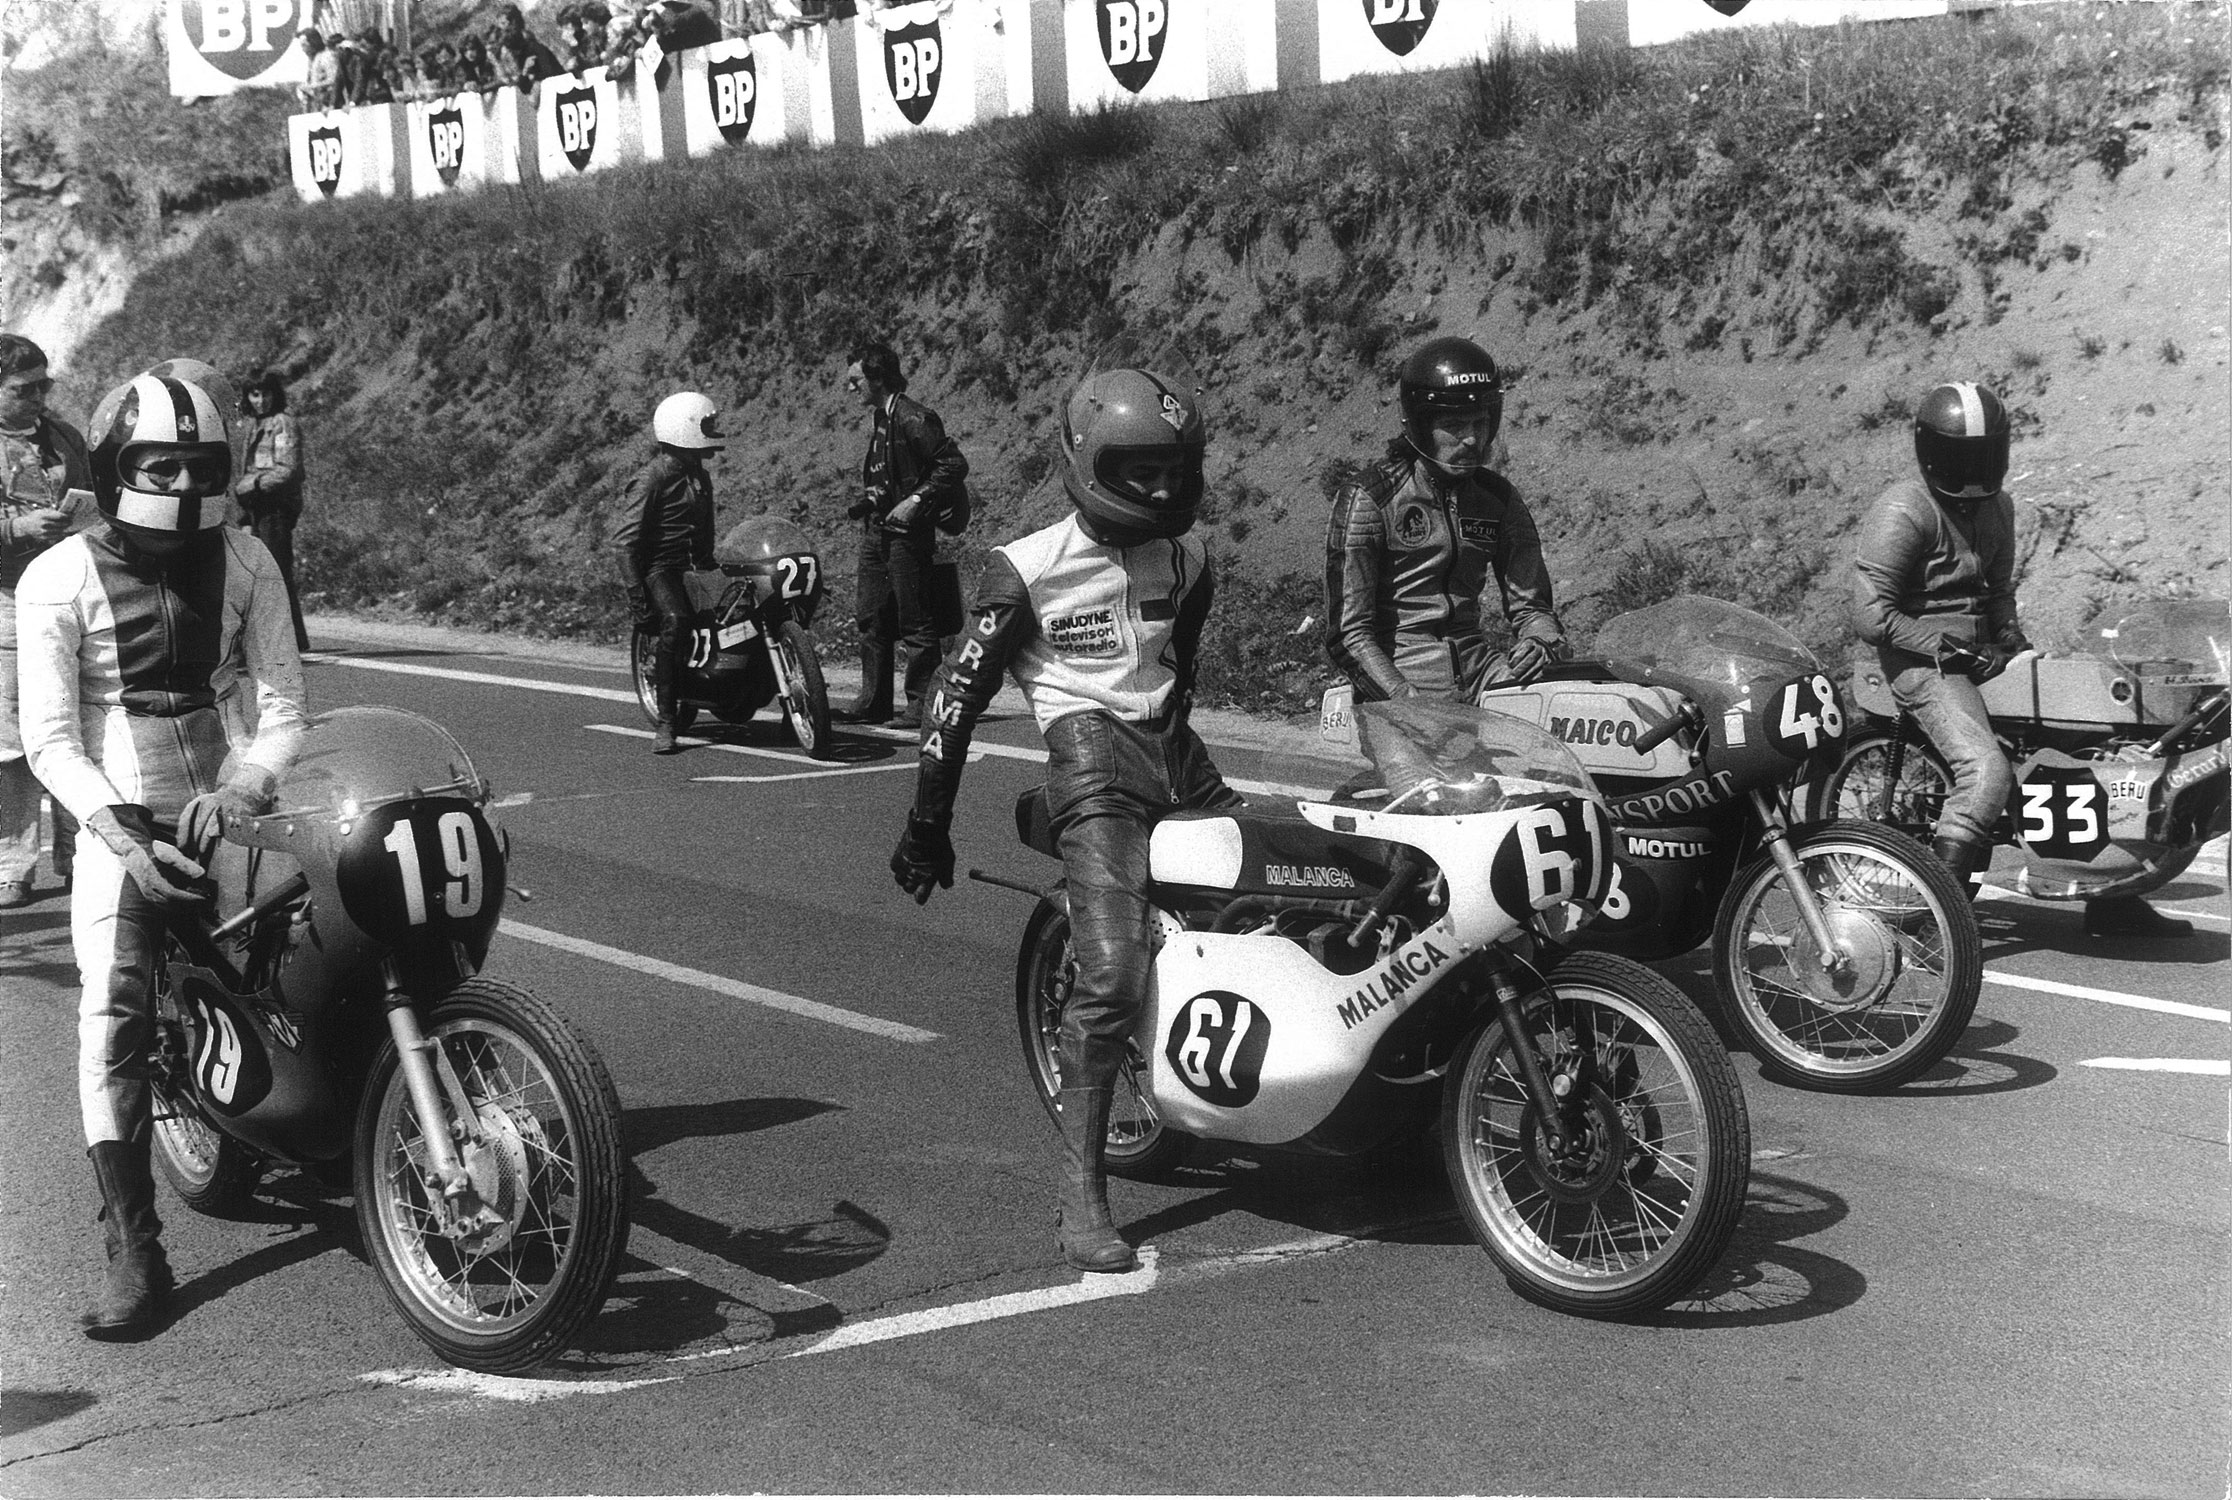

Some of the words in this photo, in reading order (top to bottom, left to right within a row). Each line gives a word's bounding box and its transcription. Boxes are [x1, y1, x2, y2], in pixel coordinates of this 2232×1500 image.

[199, 0, 293, 53] BP
[1106, 0, 1165, 66] BP
[892, 38, 940, 101] BP
[714, 70, 755, 127] BP
[431, 121, 464, 169] BP
[559, 100, 597, 152] BP
[311, 137, 342, 183] BP
[1446, 373, 1492, 386] MOTUL
[1464, 524, 1497, 536] MOTUL
[776, 556, 817, 599] 27
[1050, 610, 1113, 632] SINUDYNE
[1051, 623, 1115, 643] televisori
[1053, 638, 1117, 653] autoradio
[1322, 711, 1350, 731] BERU
[1550, 717, 1638, 748] MAICO
[1779, 674, 1843, 750] 48
[1606, 769, 1737, 823] NSPORT
[2021, 783, 2099, 844] 33
[2110, 781, 2146, 800] BERU
[383, 811, 484, 926] 19
[1516, 800, 1602, 911] 61
[1627, 836, 1712, 859] MOTUL
[1265, 864, 1355, 888] MALANCA
[1336, 940, 1450, 1031] MALANCA
[196, 998, 242, 1105] 19
[1178, 998, 1251, 1090] 61
